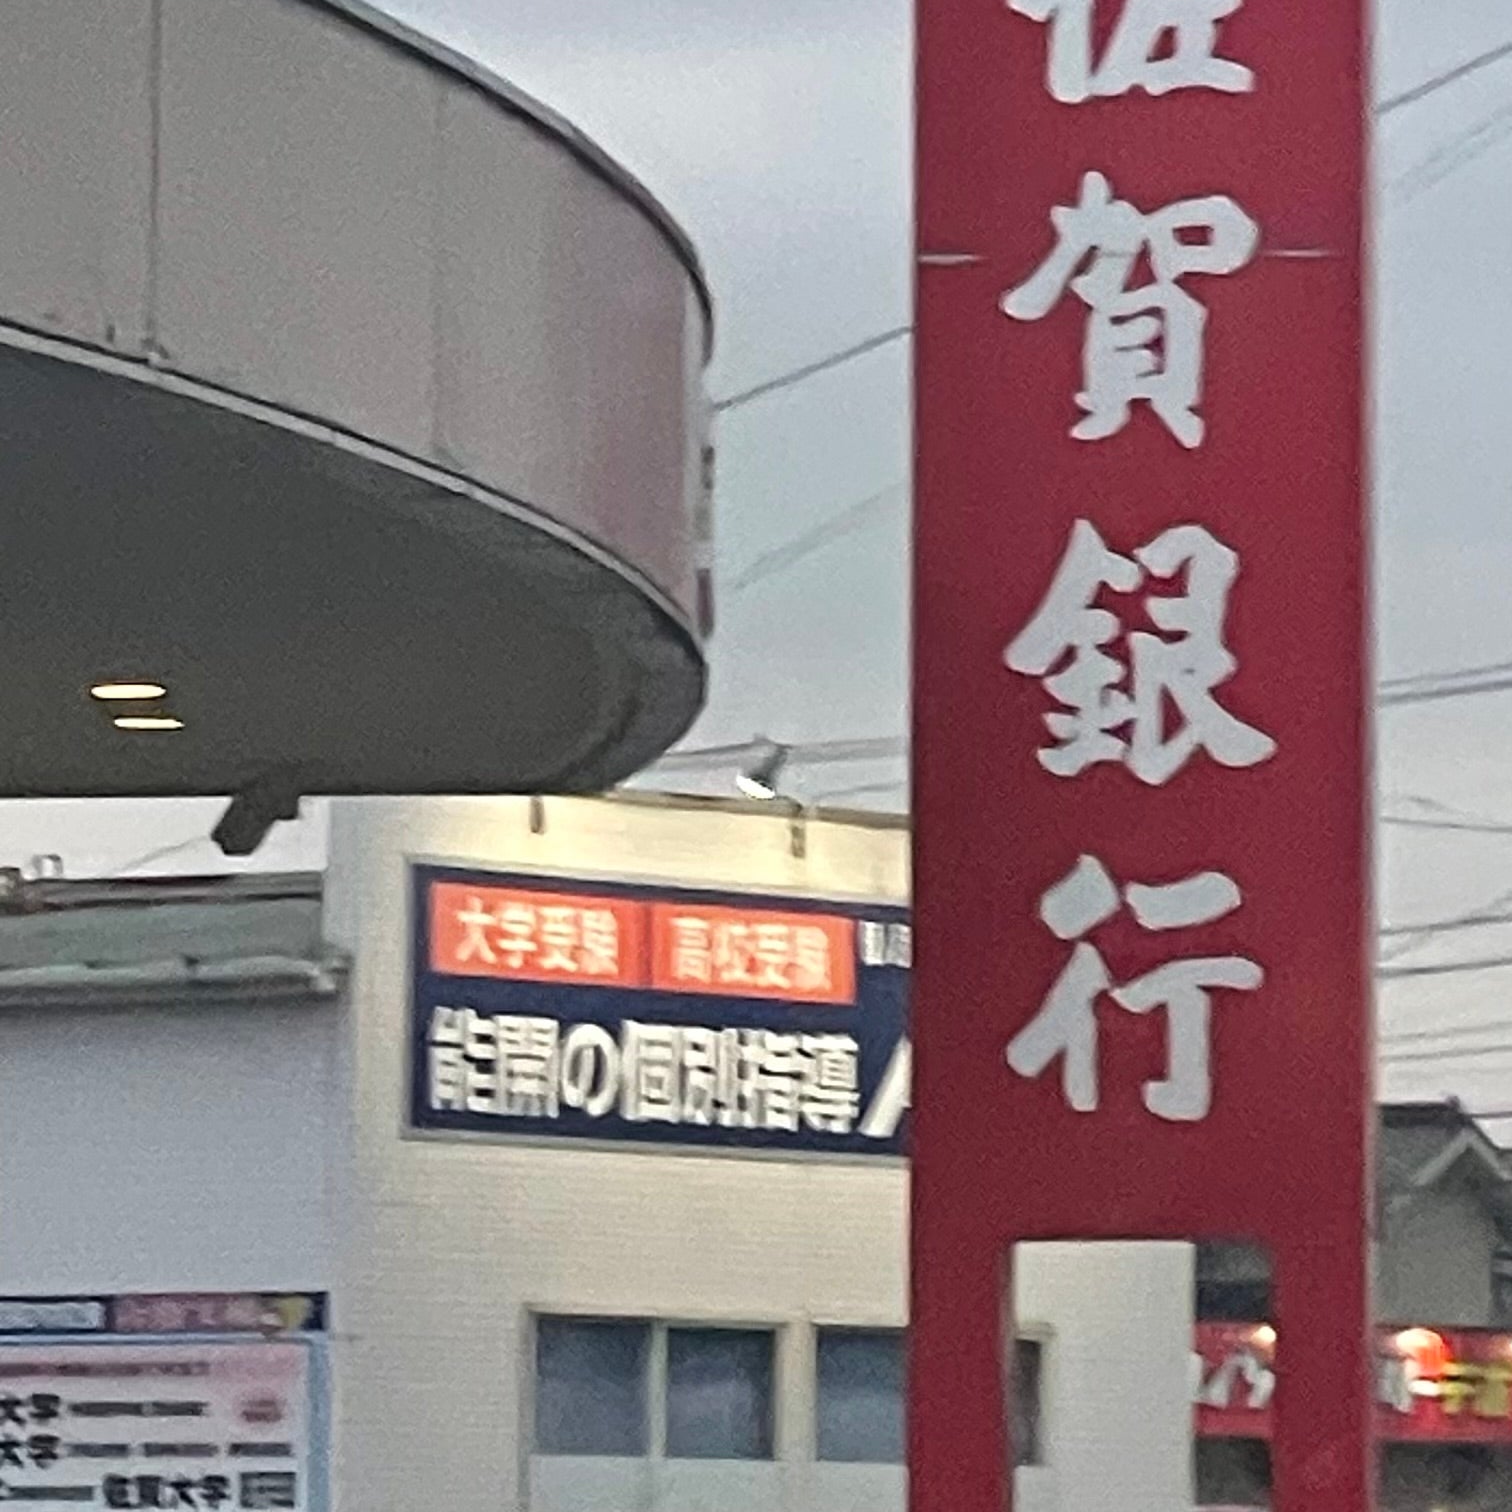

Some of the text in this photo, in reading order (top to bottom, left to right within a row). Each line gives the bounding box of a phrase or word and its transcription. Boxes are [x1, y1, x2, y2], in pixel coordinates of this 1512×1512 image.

[456, 897, 618, 976] 大学受験
[671, 916, 832, 990] 高校受験
